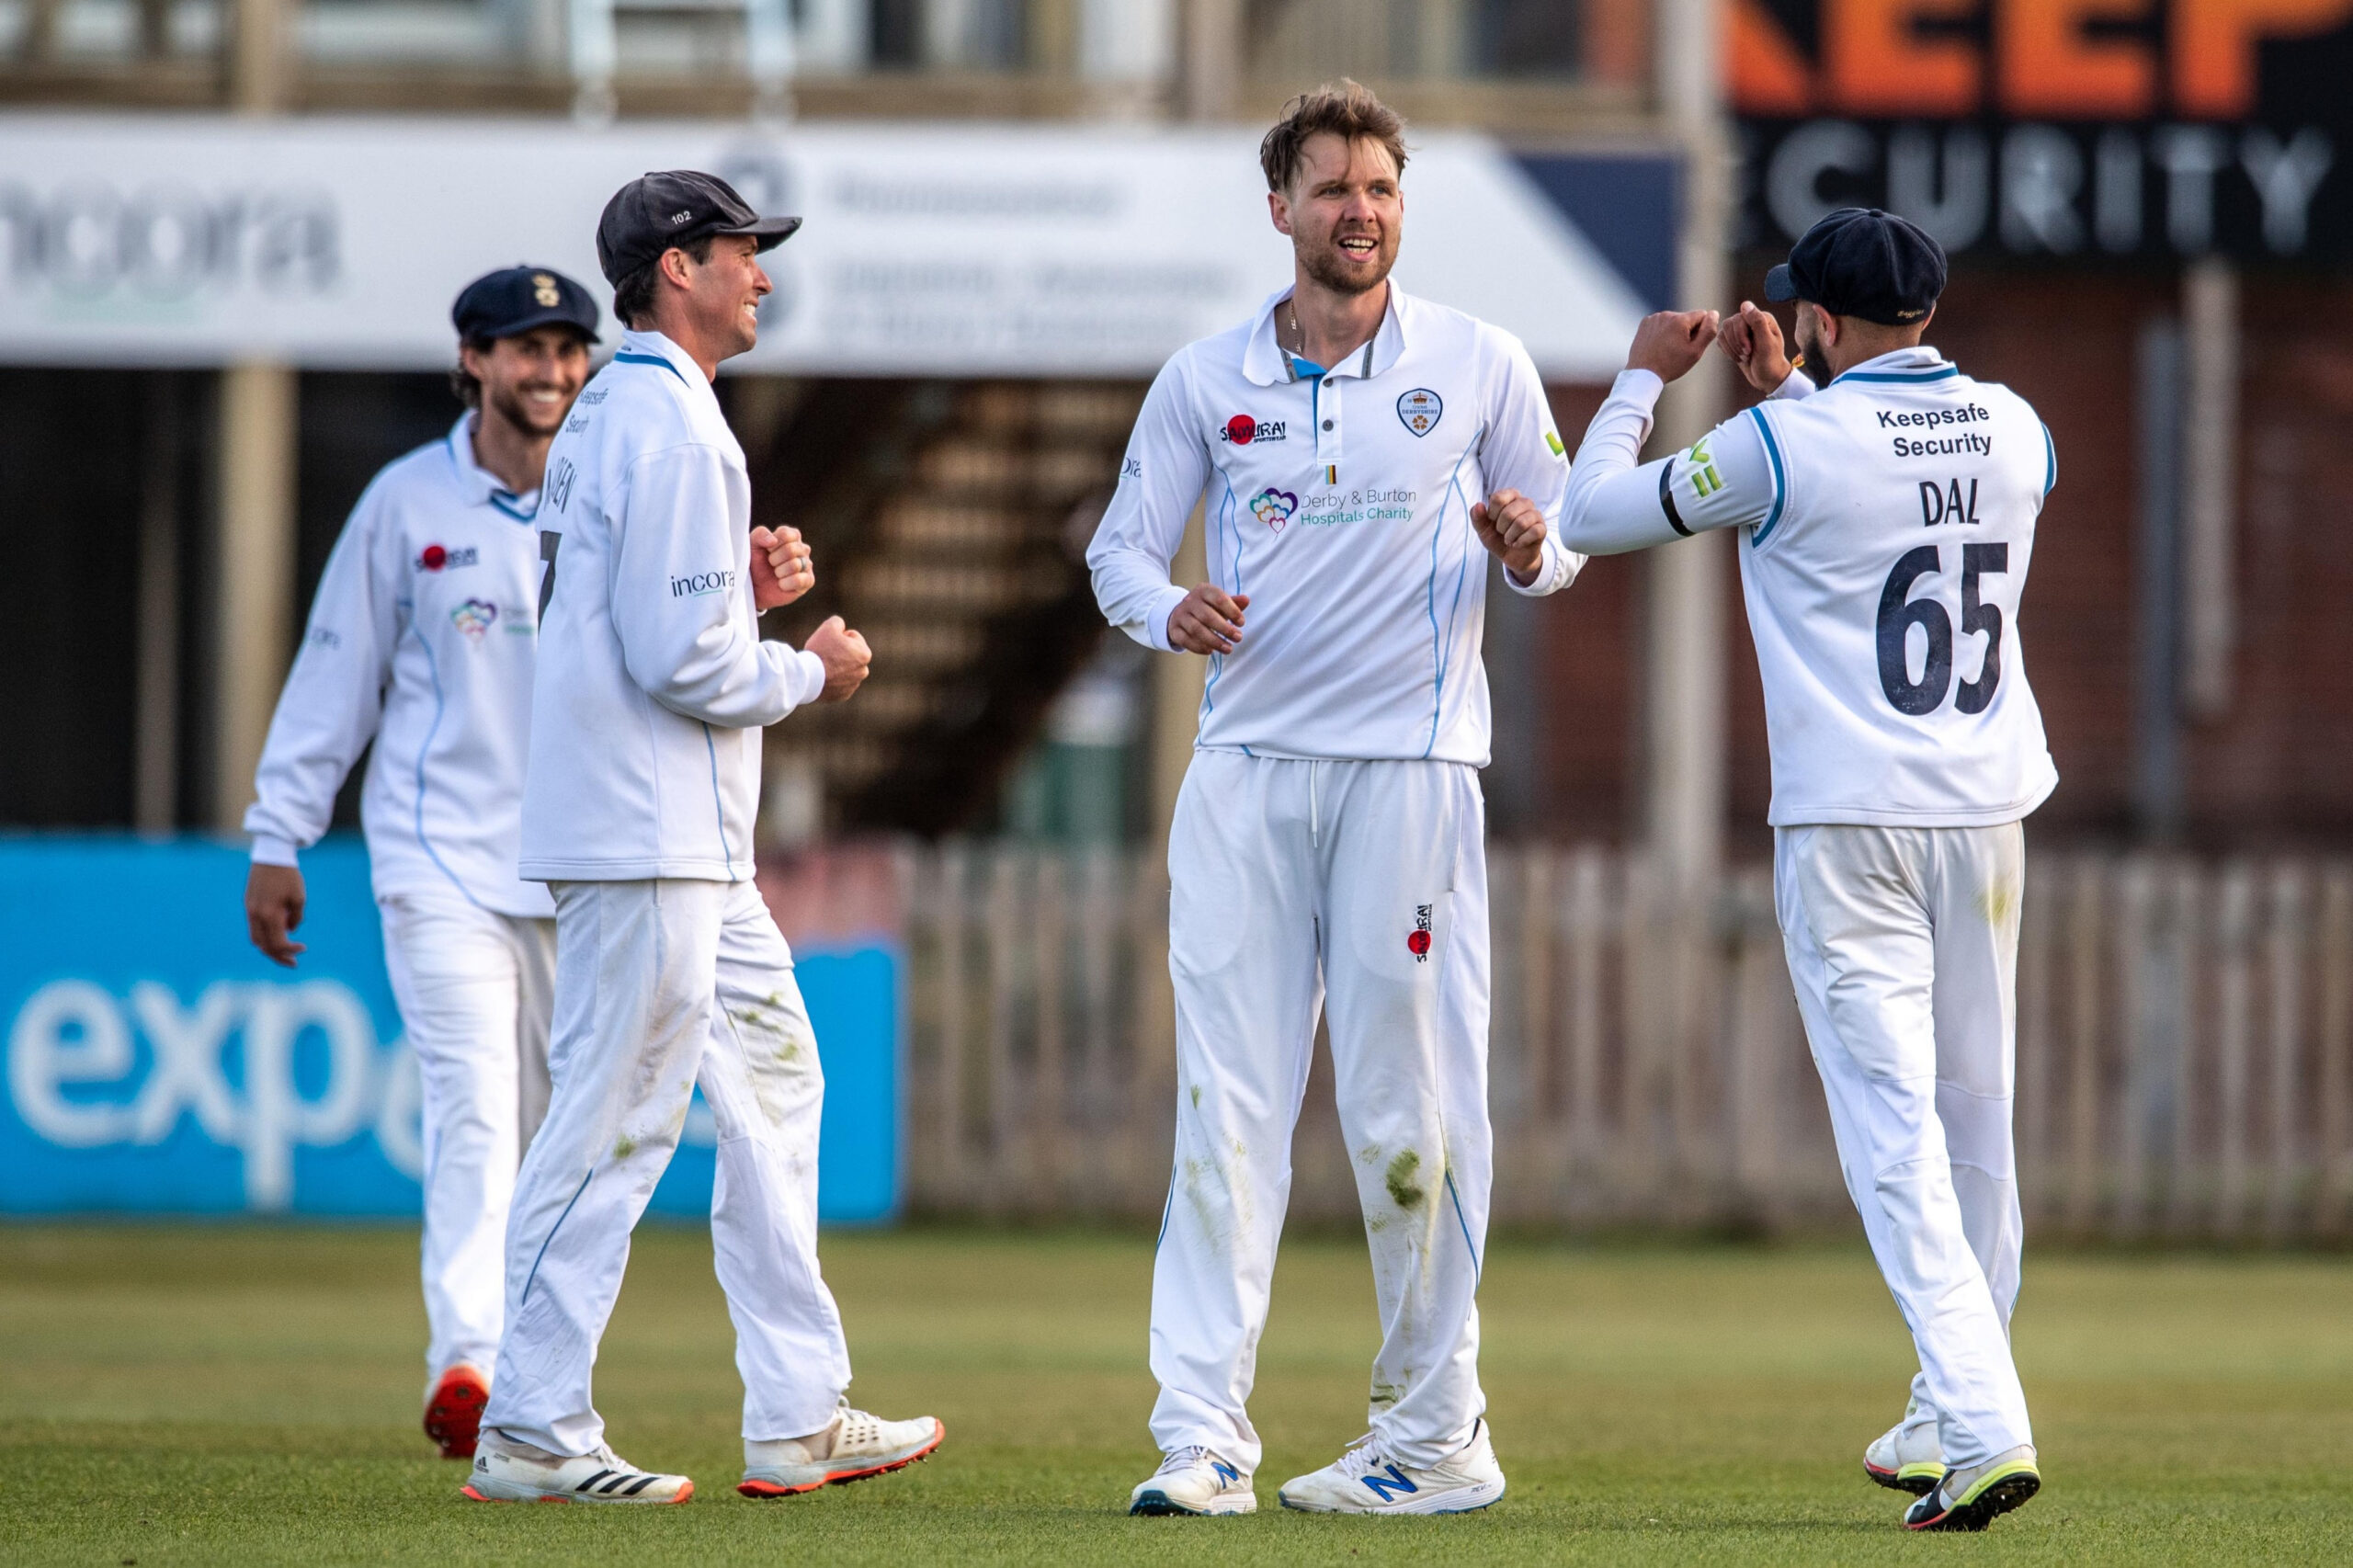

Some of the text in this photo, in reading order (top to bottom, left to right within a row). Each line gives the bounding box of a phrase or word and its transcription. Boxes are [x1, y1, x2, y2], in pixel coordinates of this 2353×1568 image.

[1728, 118, 2339, 259] CURITY
[671, 210, 692, 225] 102
[1876, 403, 1990, 430] Keepsafe
[1220, 421, 1286, 442] SAMURAI
[1893, 433, 1992, 458] Security
[1302, 488, 1416, 510] Derby & Burton
[1918, 477, 1980, 528] DAL
[1301, 506, 1414, 528] Hospitals Charity
[670, 571, 735, 597] incora
[1876, 542, 2008, 716] 65
